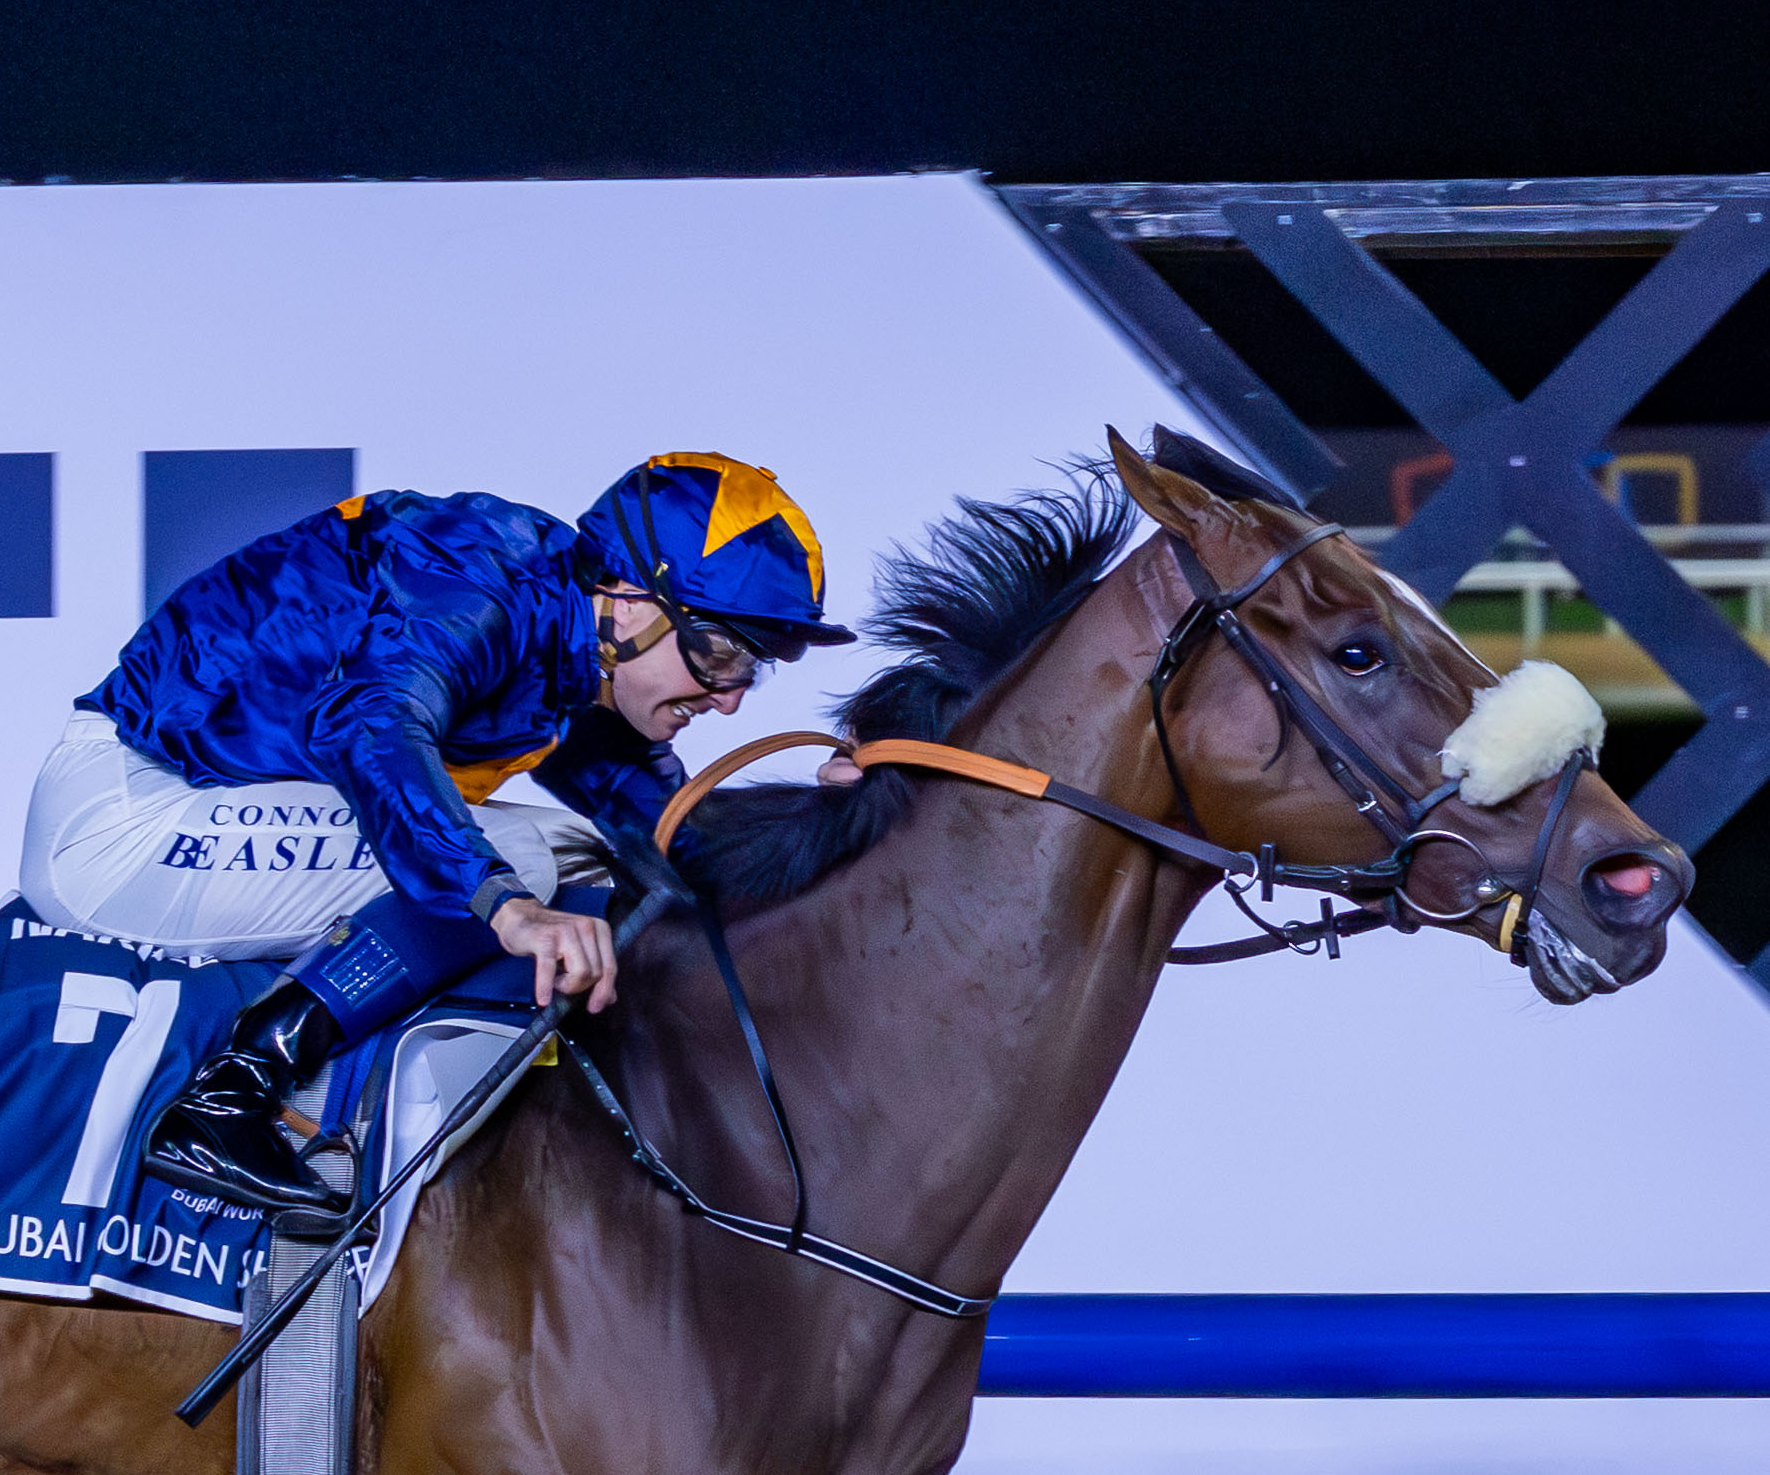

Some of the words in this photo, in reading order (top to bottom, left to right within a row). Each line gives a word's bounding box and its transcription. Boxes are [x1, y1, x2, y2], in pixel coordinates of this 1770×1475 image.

[209, 803, 354, 826] CONNO
[158, 831, 375, 871] BEASLE
[52, 971, 181, 1208] 7
[171, 1188, 224, 1215] DUBAI
[97, 1214, 229, 1285] OLDEN
